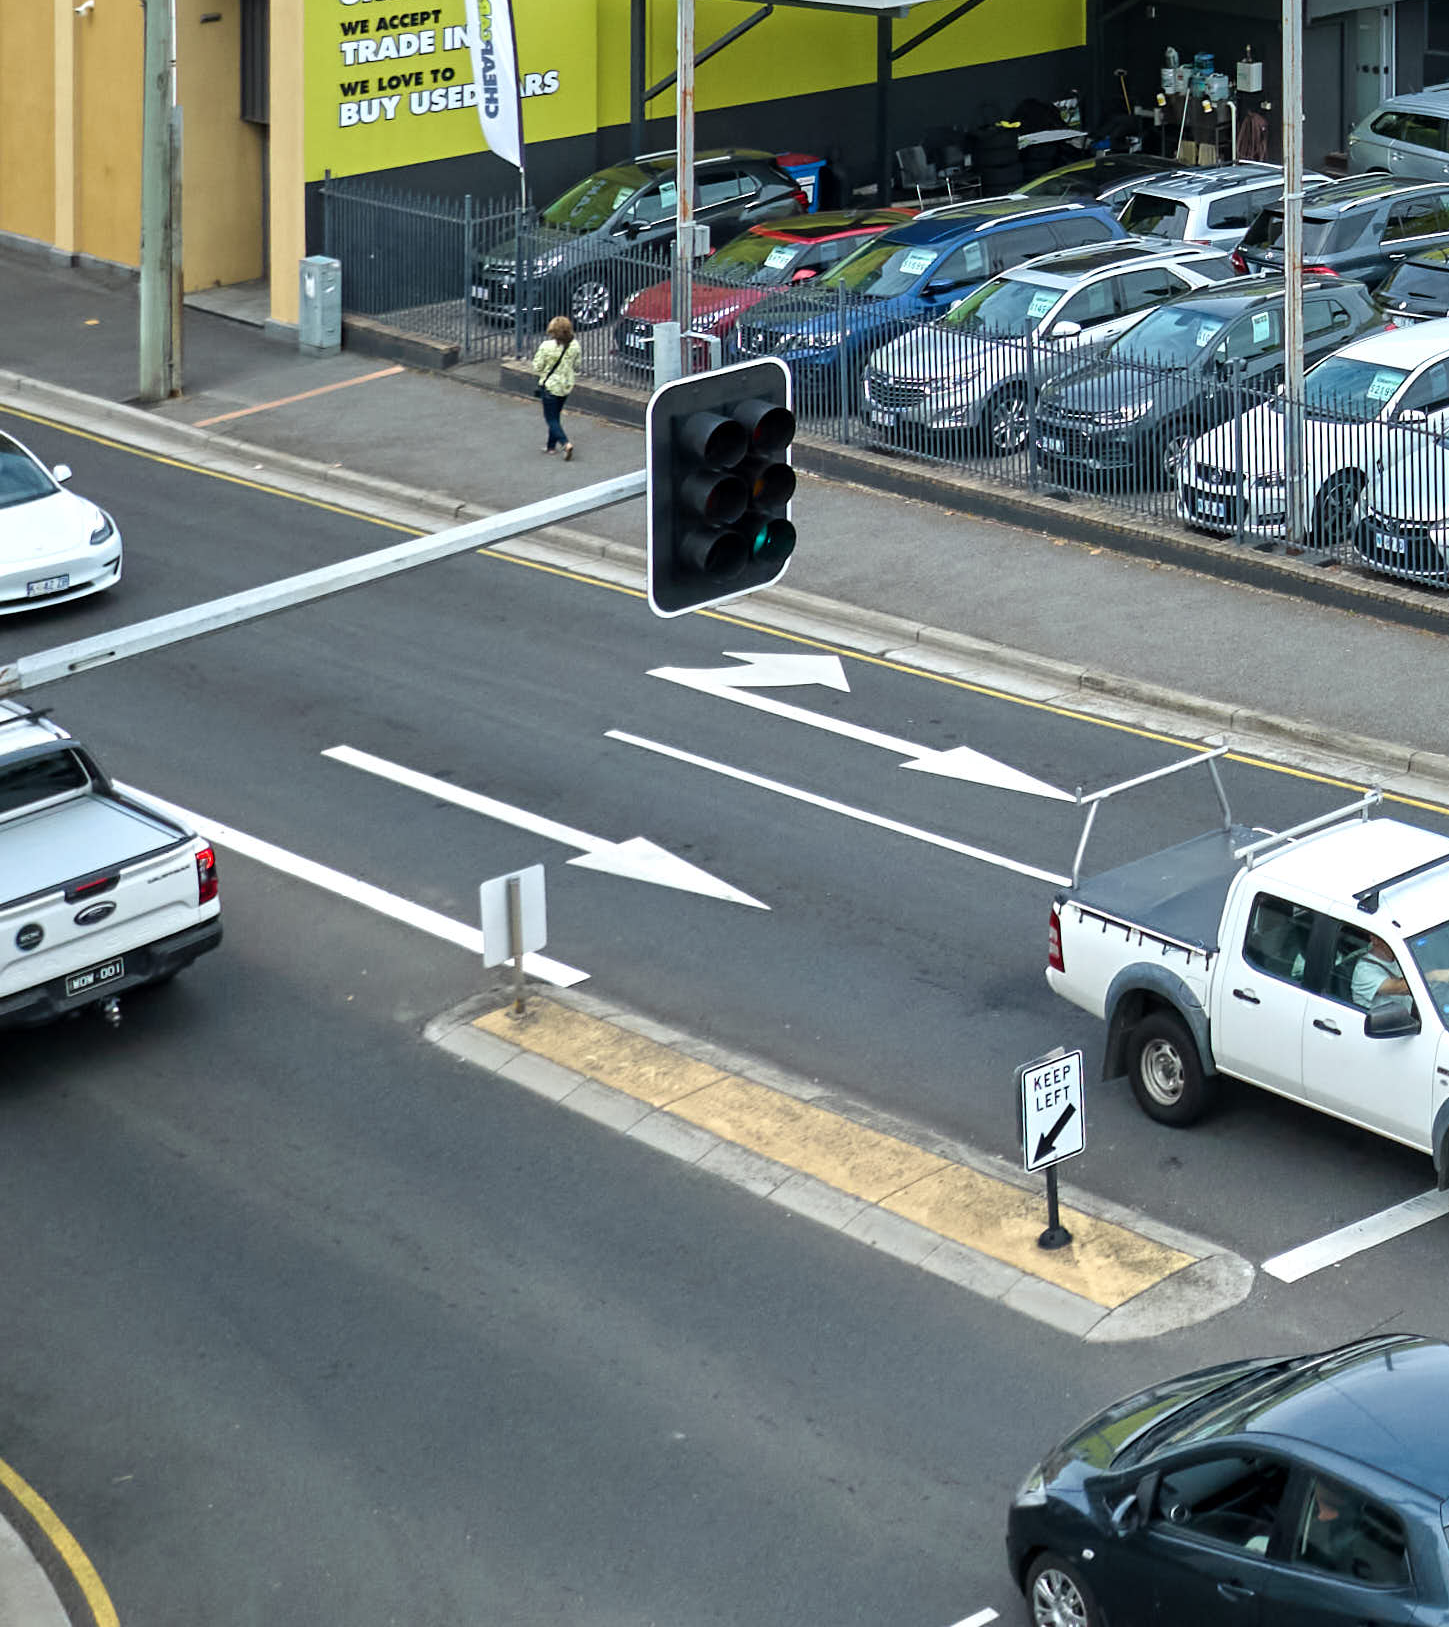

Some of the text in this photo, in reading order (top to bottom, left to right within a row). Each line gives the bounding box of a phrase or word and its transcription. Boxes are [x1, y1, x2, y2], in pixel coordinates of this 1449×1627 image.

[340, 9, 442, 36] WE ACCEPT
[340, 24, 472, 66] TRADE IN
[340, 67, 455, 97] WE LOVE TO
[339, 83, 480, 128] BUY USED
[1033, 1065, 1071, 1092] KEEP
[1036, 1085, 1070, 1112] LEFT
